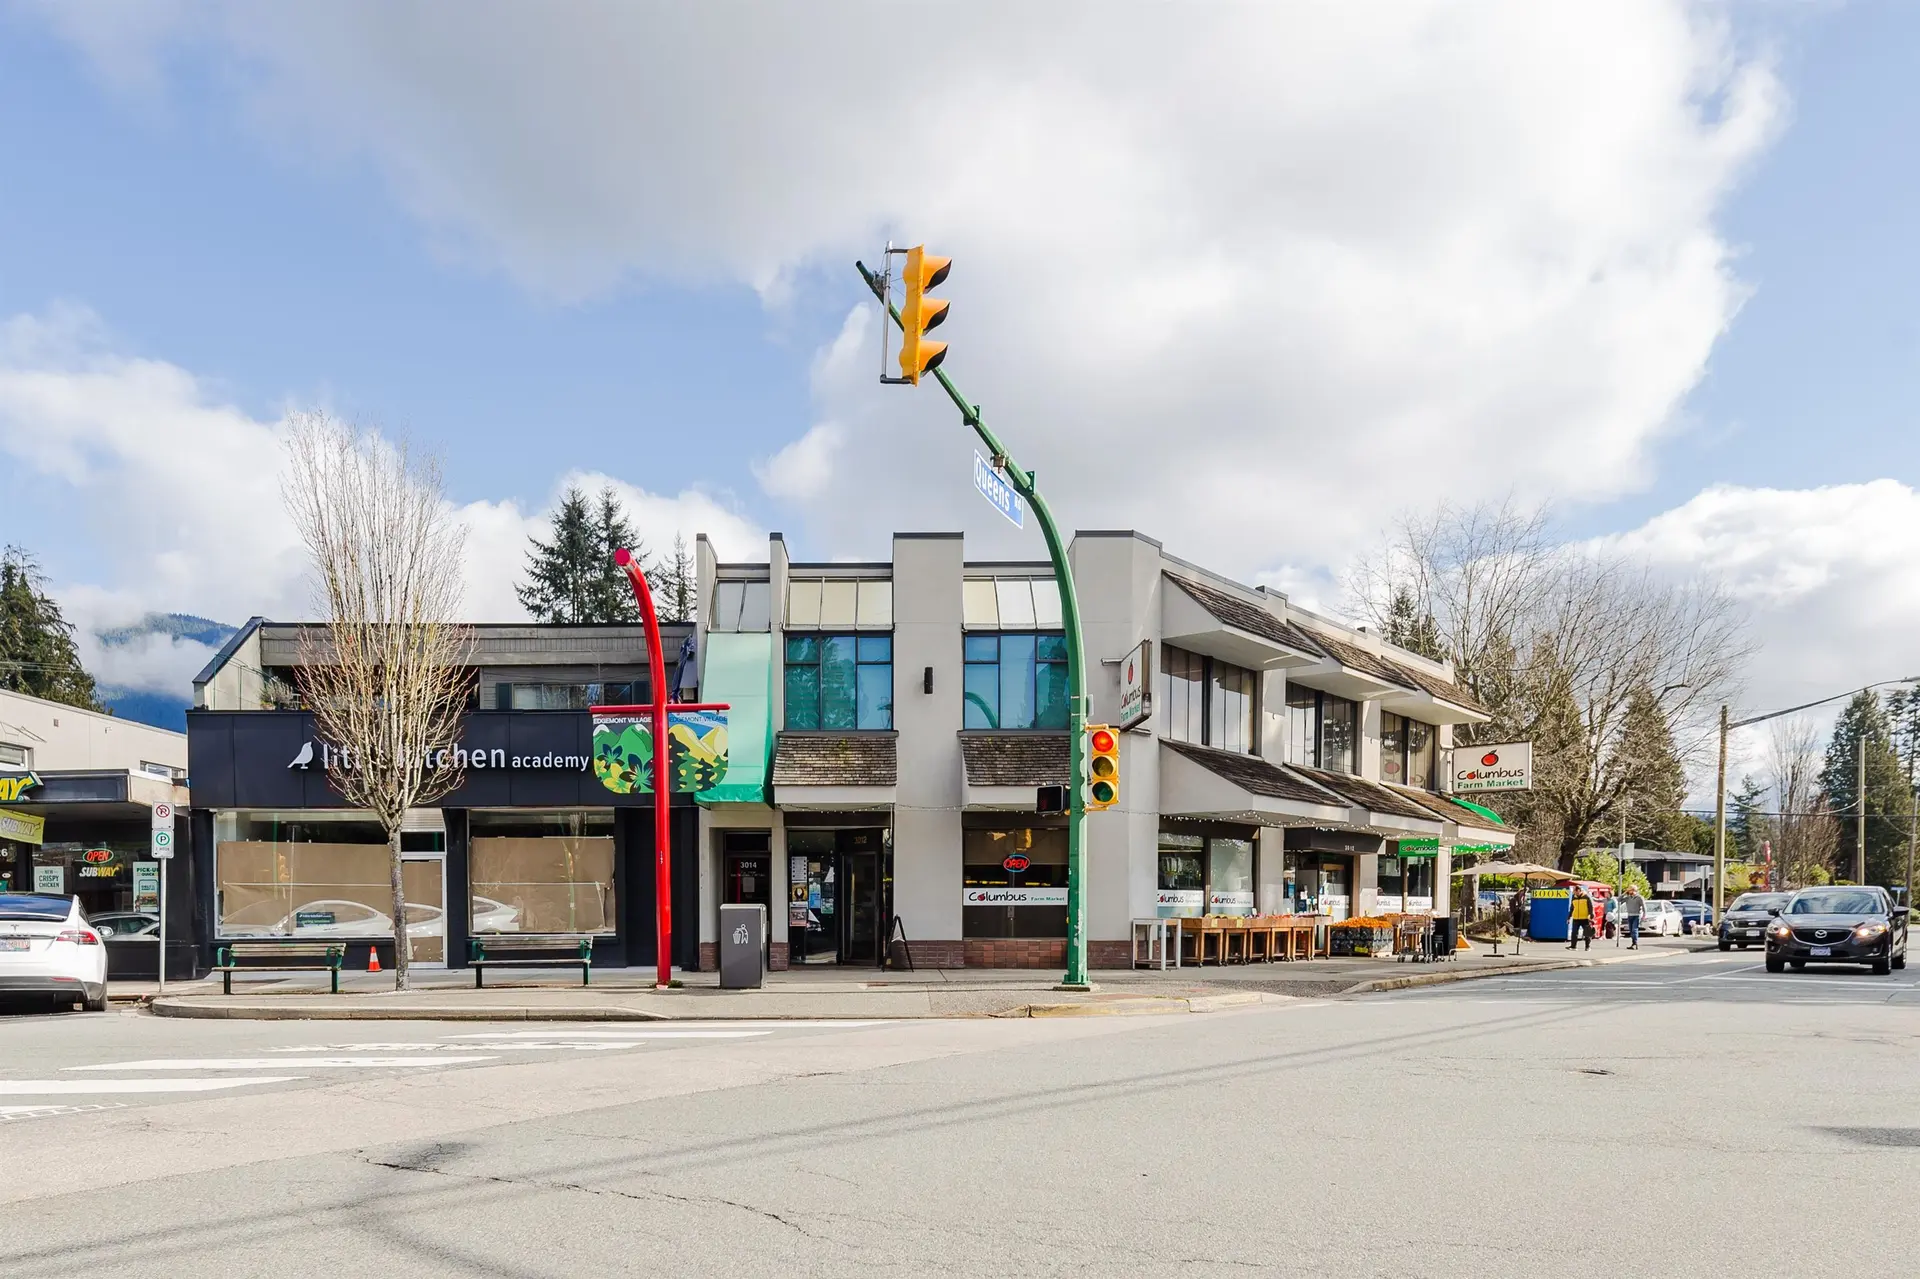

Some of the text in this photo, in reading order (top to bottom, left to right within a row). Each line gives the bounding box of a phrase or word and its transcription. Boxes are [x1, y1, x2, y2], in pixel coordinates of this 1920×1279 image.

[976, 456, 1010, 512] Queens
[323, 744, 387, 769] litt
[512, 752, 589, 771] academy
[1457, 767, 1524, 780] Columbus
[1457, 779, 1523, 789] Farm Market
[1, 817, 41, 837] SUBWAY
[86, 850, 110, 861] OPEN
[1006, 858, 1028, 869] OPEN
[79, 865, 119, 877] SUBWAY
[968, 891, 1027, 901] Columbus
[1532, 890, 1569, 898] BOOKS
